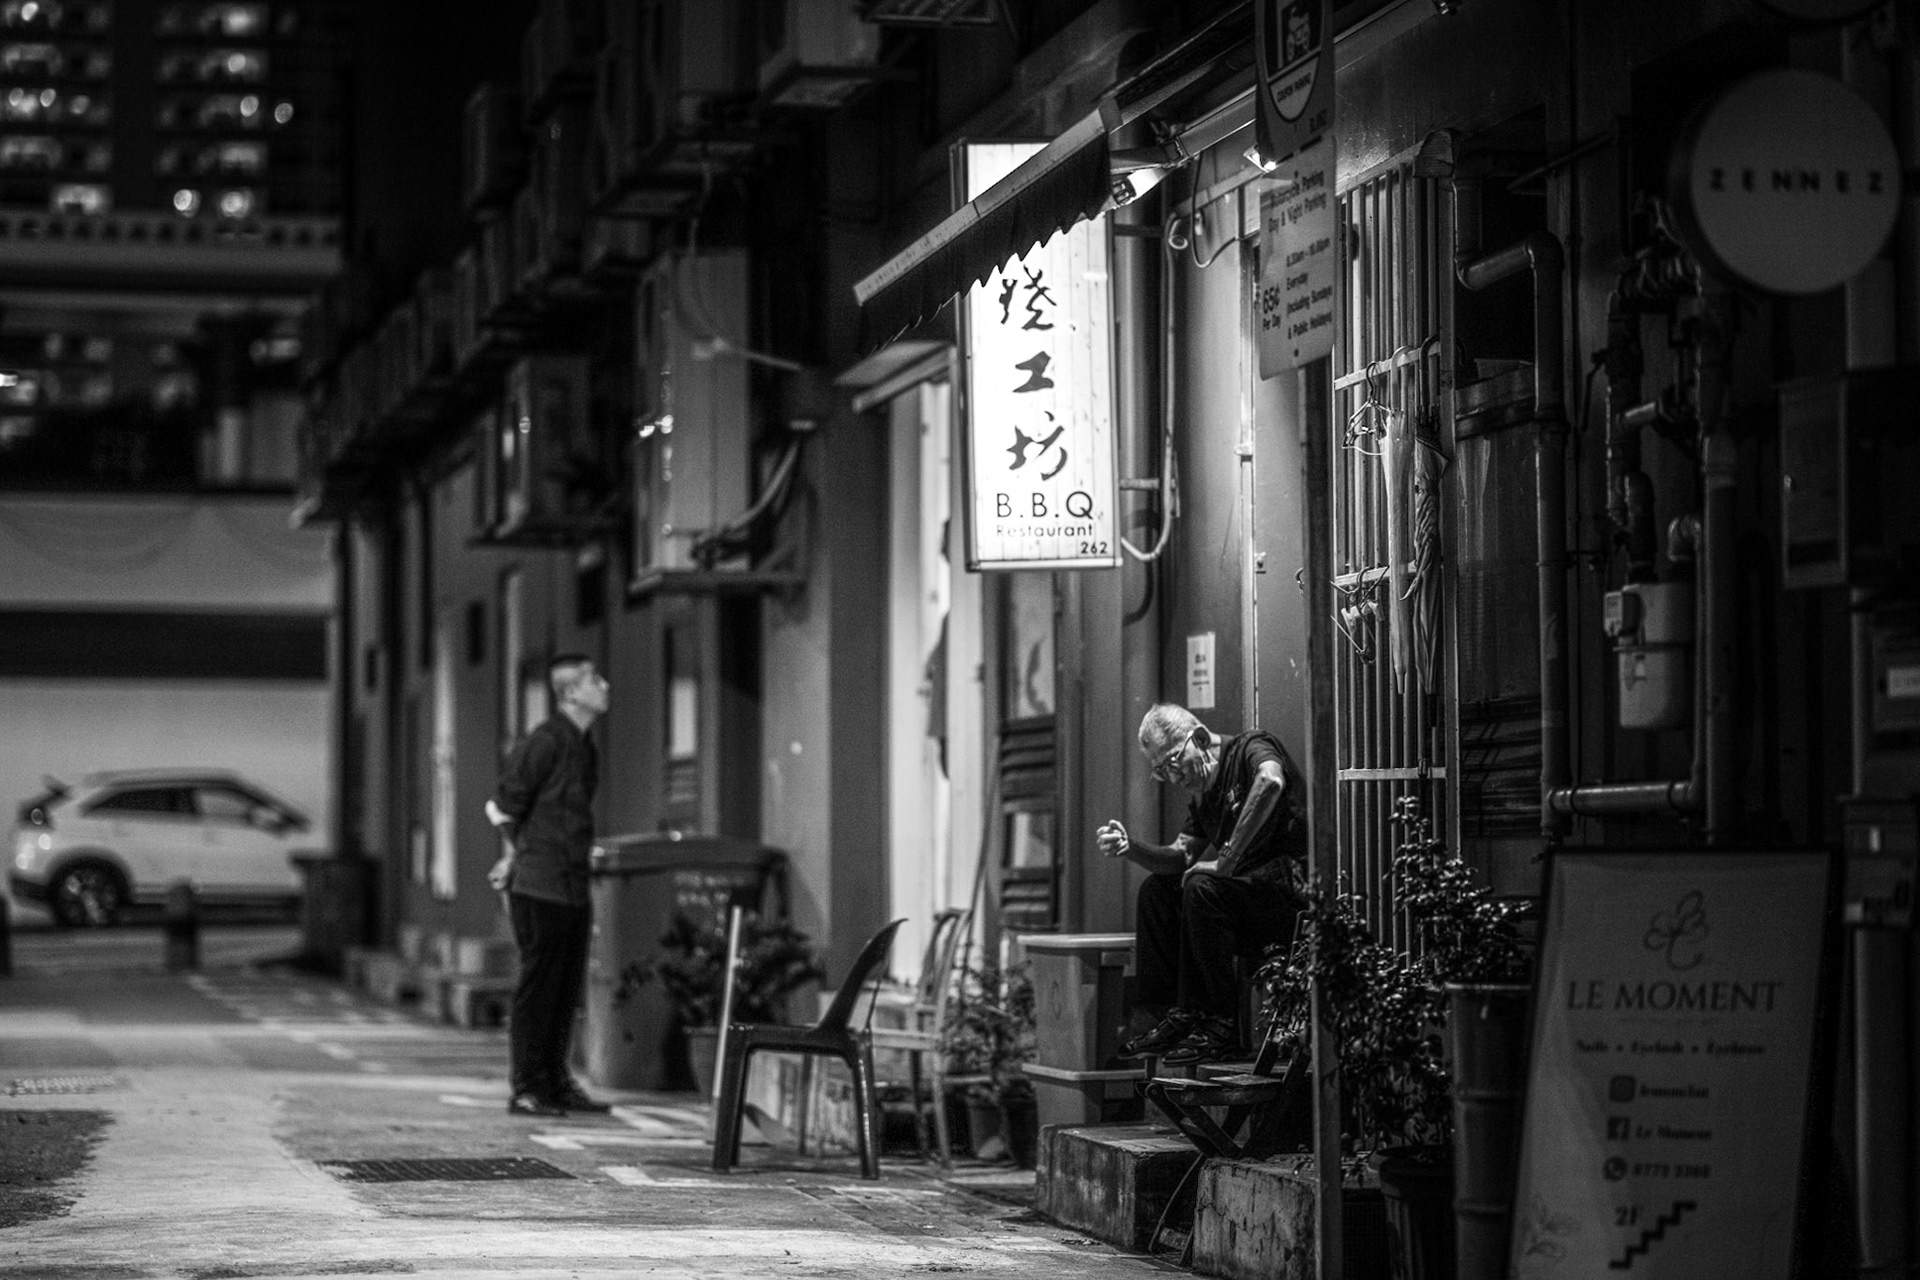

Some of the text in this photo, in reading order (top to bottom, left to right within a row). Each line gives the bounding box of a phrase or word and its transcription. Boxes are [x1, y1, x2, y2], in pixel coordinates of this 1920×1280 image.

[1710, 168, 1882, 194] ZENNEZ
[997, 491, 1093, 520] B.B.Q
[997, 523, 1093, 537] Restaurant
[1080, 541, 1108, 555] 262
[1567, 980, 1785, 1012] LE MOMENT
